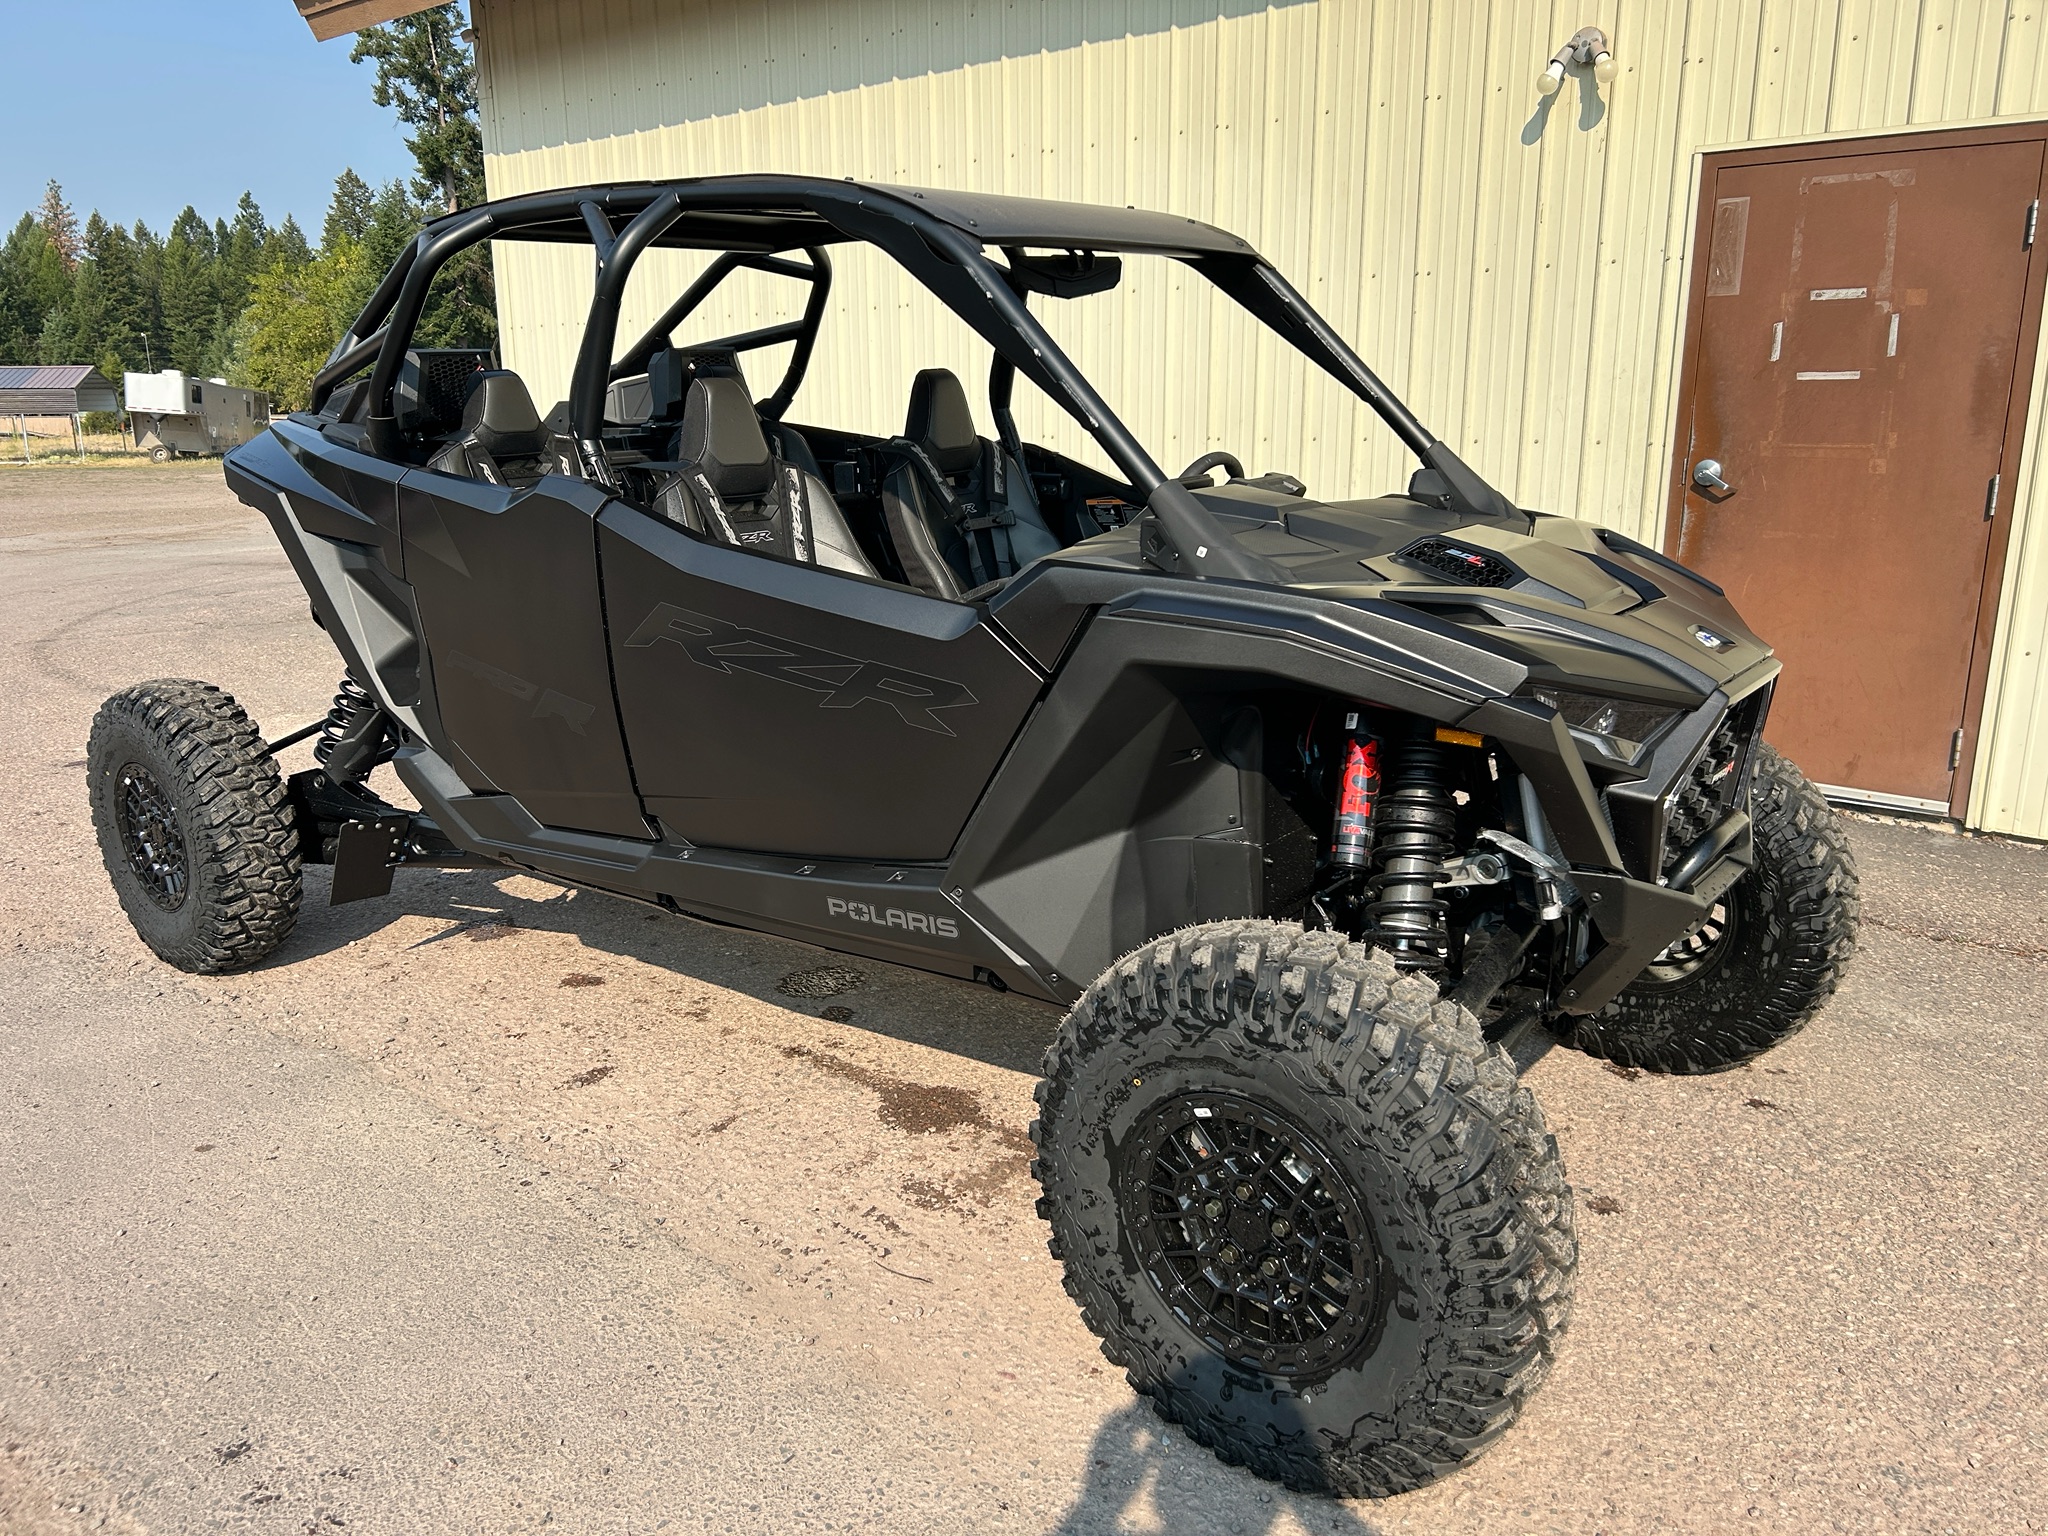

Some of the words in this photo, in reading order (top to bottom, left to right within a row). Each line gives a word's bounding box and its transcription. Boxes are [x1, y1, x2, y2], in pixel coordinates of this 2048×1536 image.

[624, 602, 979, 737] RZR
[1340, 739, 1381, 817] FOX
[826, 896, 960, 938] POLARIS
